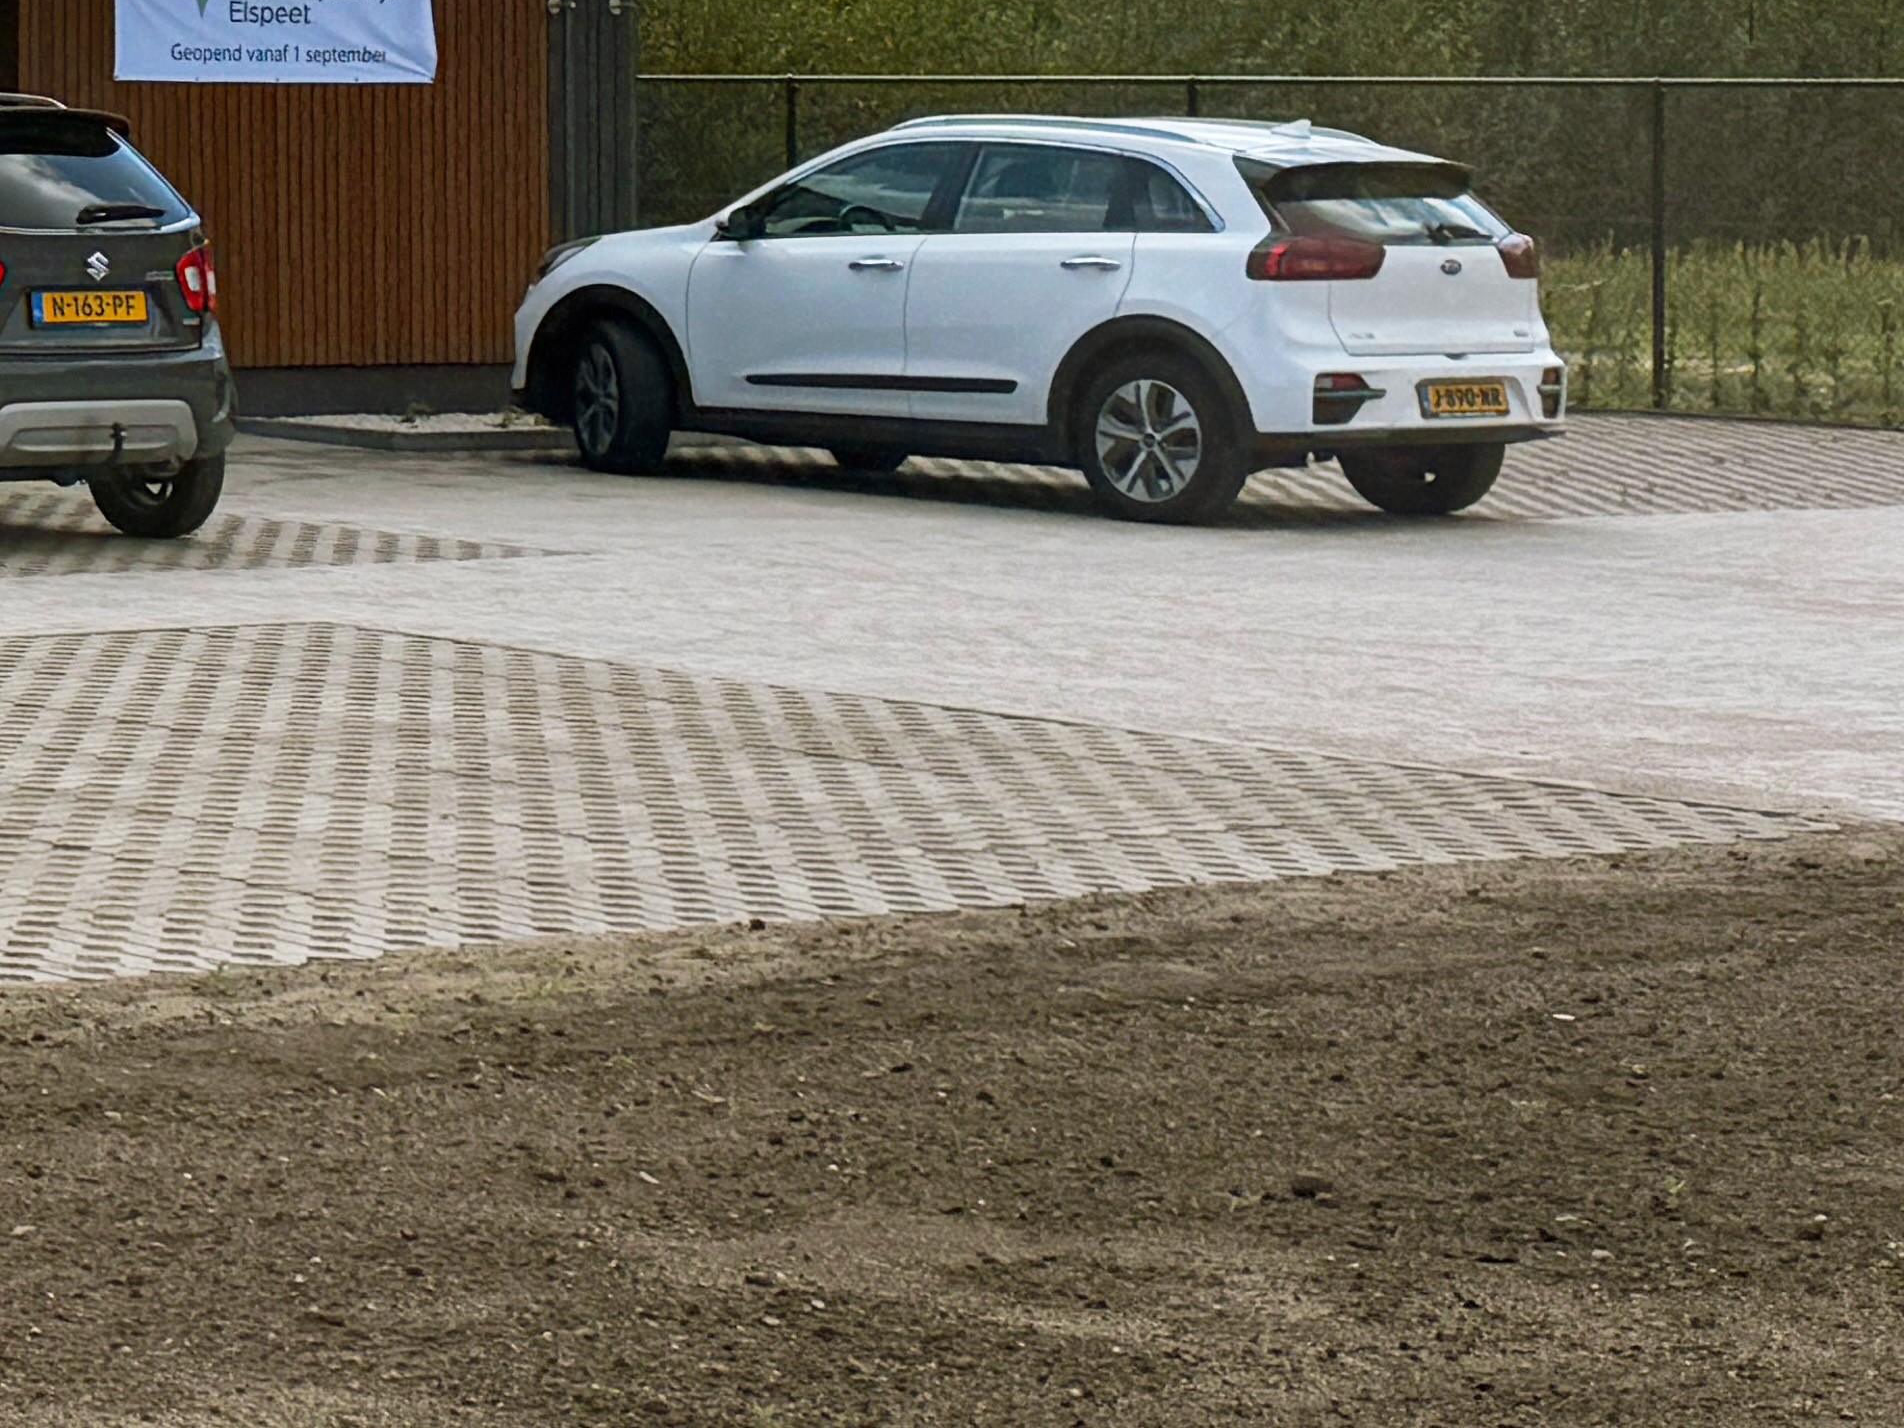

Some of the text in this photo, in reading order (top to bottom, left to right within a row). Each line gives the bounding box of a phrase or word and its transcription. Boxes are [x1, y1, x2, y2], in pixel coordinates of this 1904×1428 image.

[229, 0, 311, 26] Elspeet
[171, 43, 242, 64] Geopend
[246, 44, 289, 62] vanaf
[294, 45, 300, 62] 1
[52, 294, 136, 317] N-163-PF
